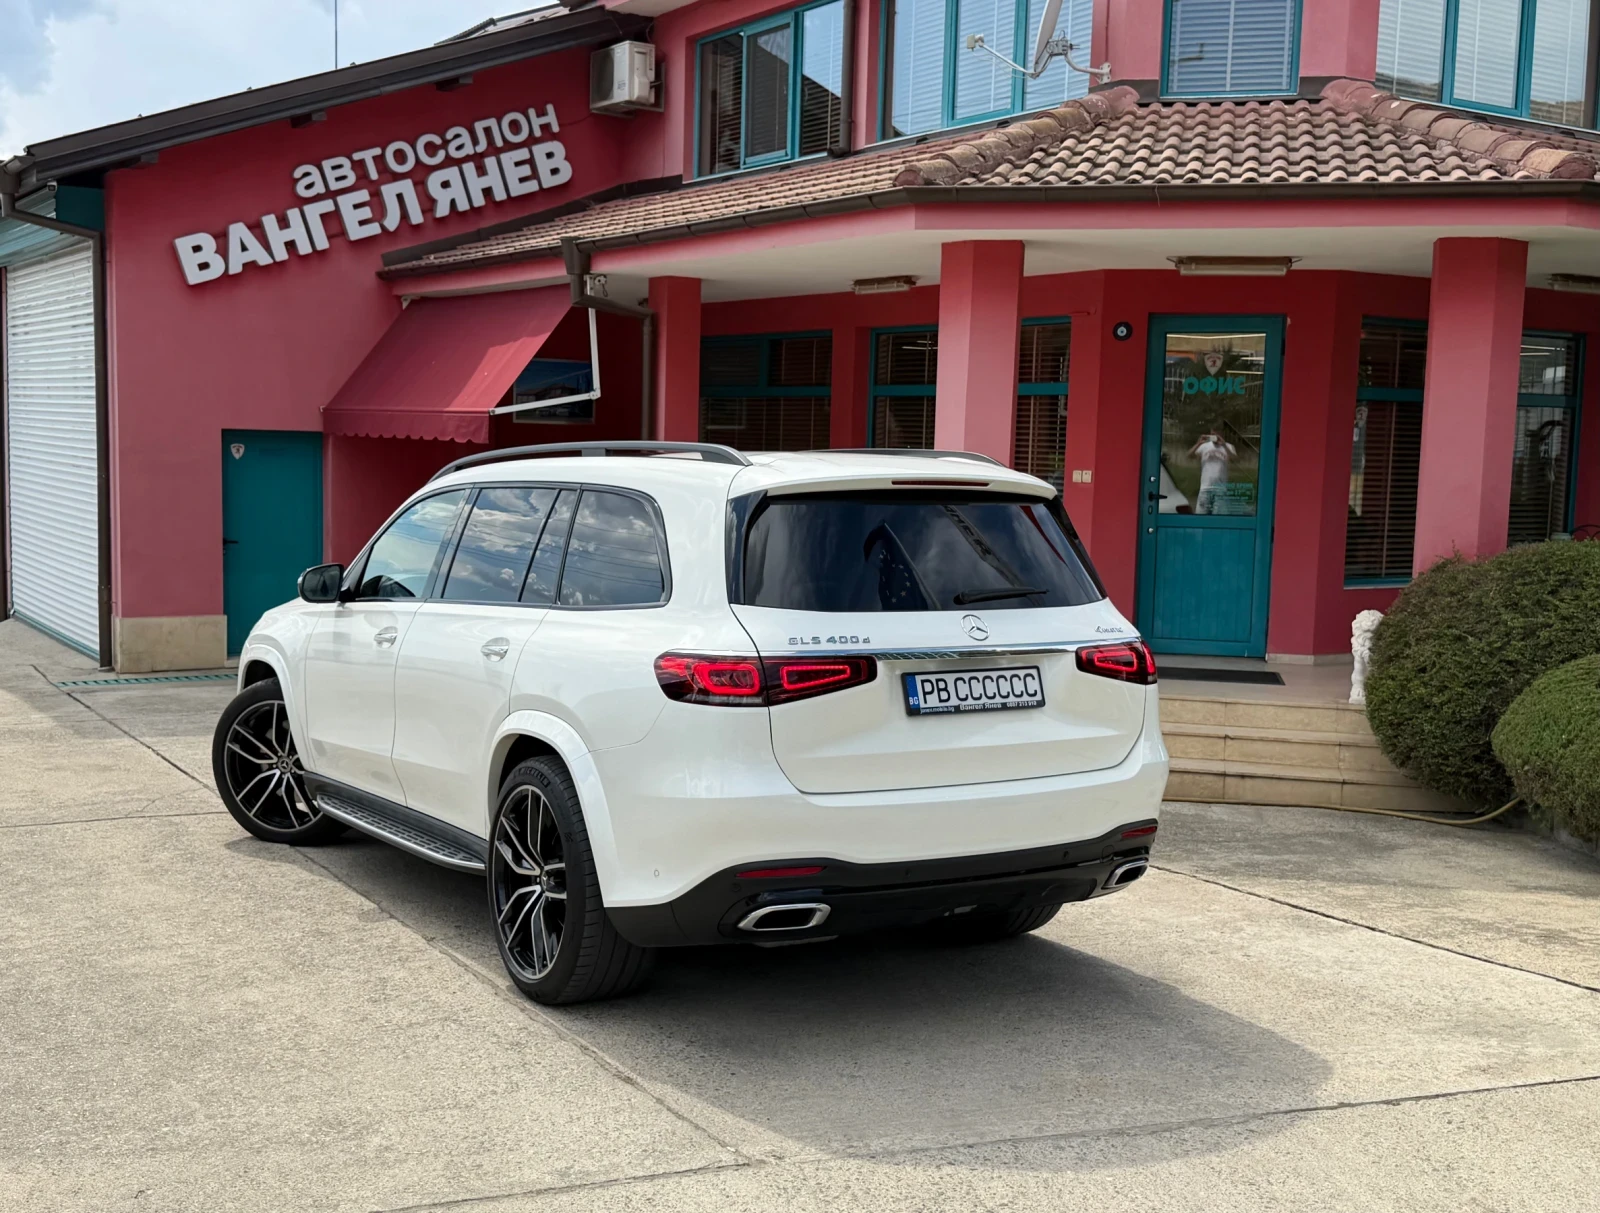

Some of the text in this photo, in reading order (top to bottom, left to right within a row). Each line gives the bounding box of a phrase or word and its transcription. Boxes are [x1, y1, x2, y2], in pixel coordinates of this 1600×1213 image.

[292, 103, 560, 198] автосалон
[173, 140, 573, 286] ВАНГЕЛ ЯНЕВ
[1182, 376, 1246, 396] ОФИС
[788, 636, 821, 645] GLS
[909, 696, 919, 705] BG
[920, 673, 1038, 704] PB CCCCCC
